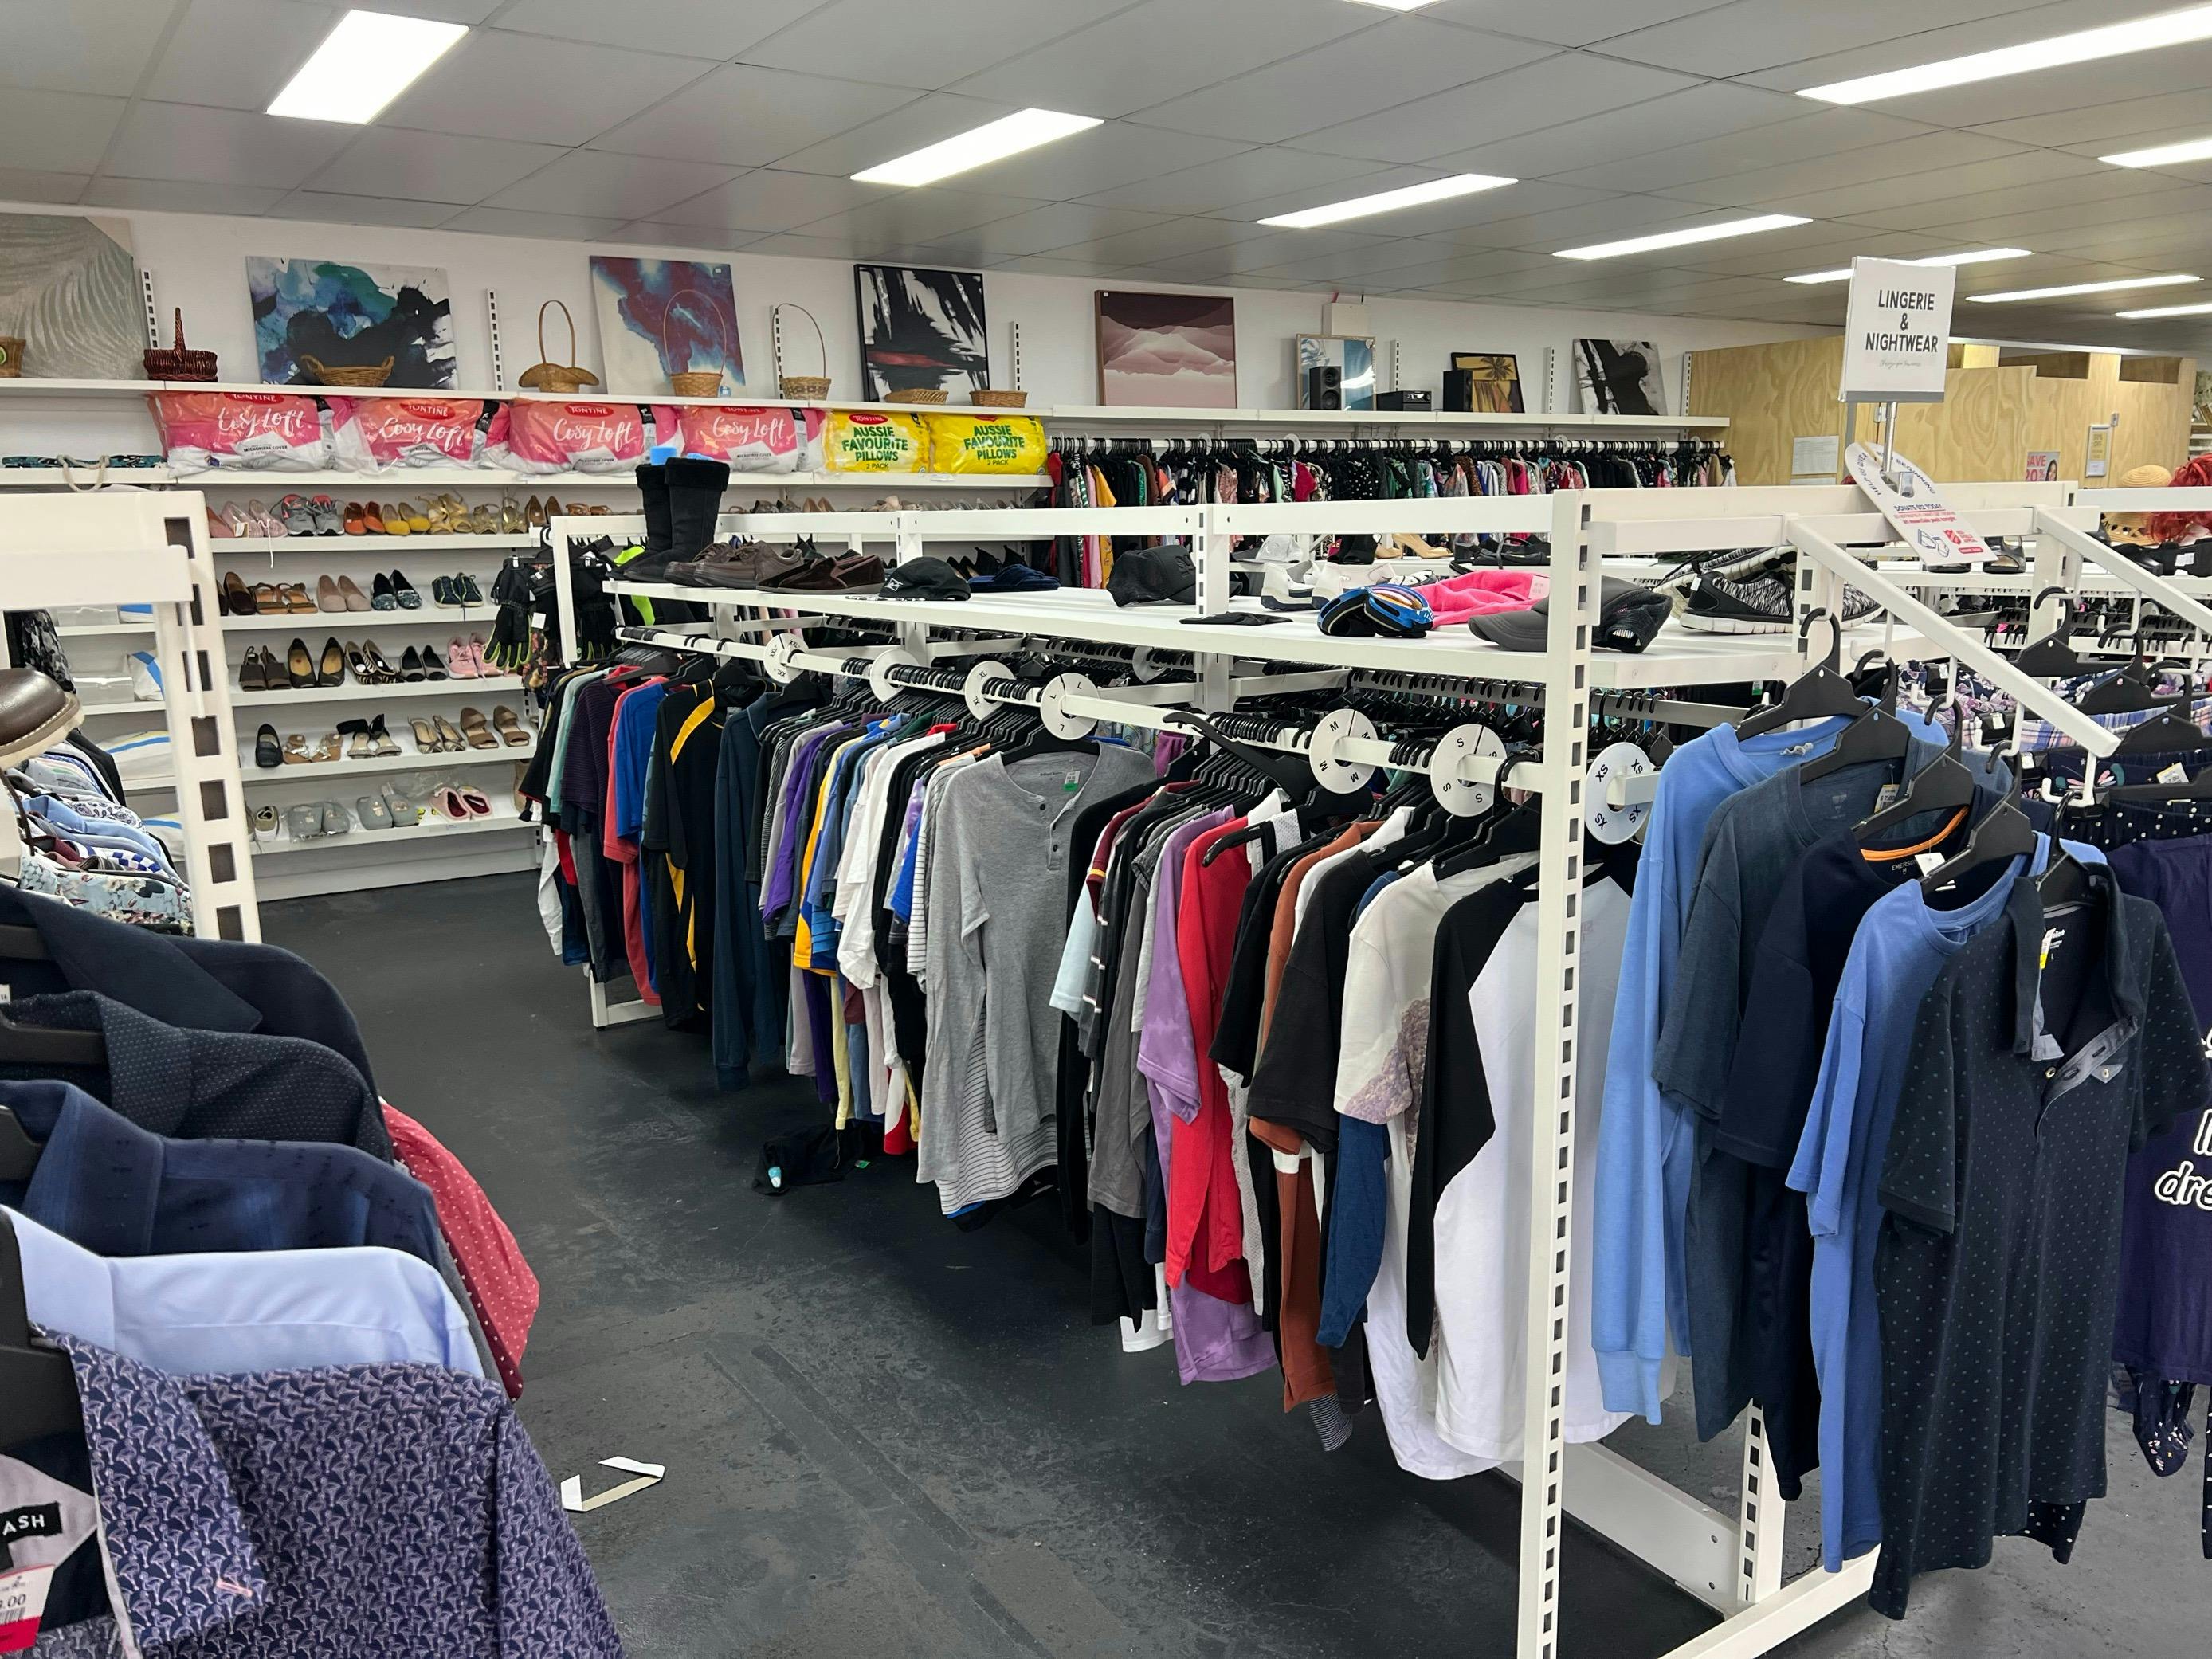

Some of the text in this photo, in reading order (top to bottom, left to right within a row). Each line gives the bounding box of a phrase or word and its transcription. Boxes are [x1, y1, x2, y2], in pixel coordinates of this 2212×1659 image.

[1878, 289, 1936, 311] LINGERIE
[1900, 312, 1909, 331] &
[1865, 332, 1939, 352] NIGHTWEAR
[569, 405, 609, 414] TONTINE
[553, 418, 638, 453] Cosy Loft
[712, 416, 786, 447] Cosy Loft
[853, 426, 895, 438] AUSSIE
[973, 425, 1013, 436] AUSSIE
[841, 437, 908, 452] FAVOURITE
[963, 436, 1025, 450] FAVOURITE
[855, 450, 899, 462] PILLOWS
[977, 449, 1018, 461] PILLOWS
[1329, 720, 1339, 732] M
[1457, 737, 1465, 747] S
[1595, 763, 1609, 782] XS
[1631, 759, 1643, 775] XS
[1442, 782, 1451, 792] S
[1475, 793, 1483, 803] S
[1594, 813, 1607, 830] XS
[1629, 805, 1641, 823] XS
[2, 1514, 45, 1536] ASH
